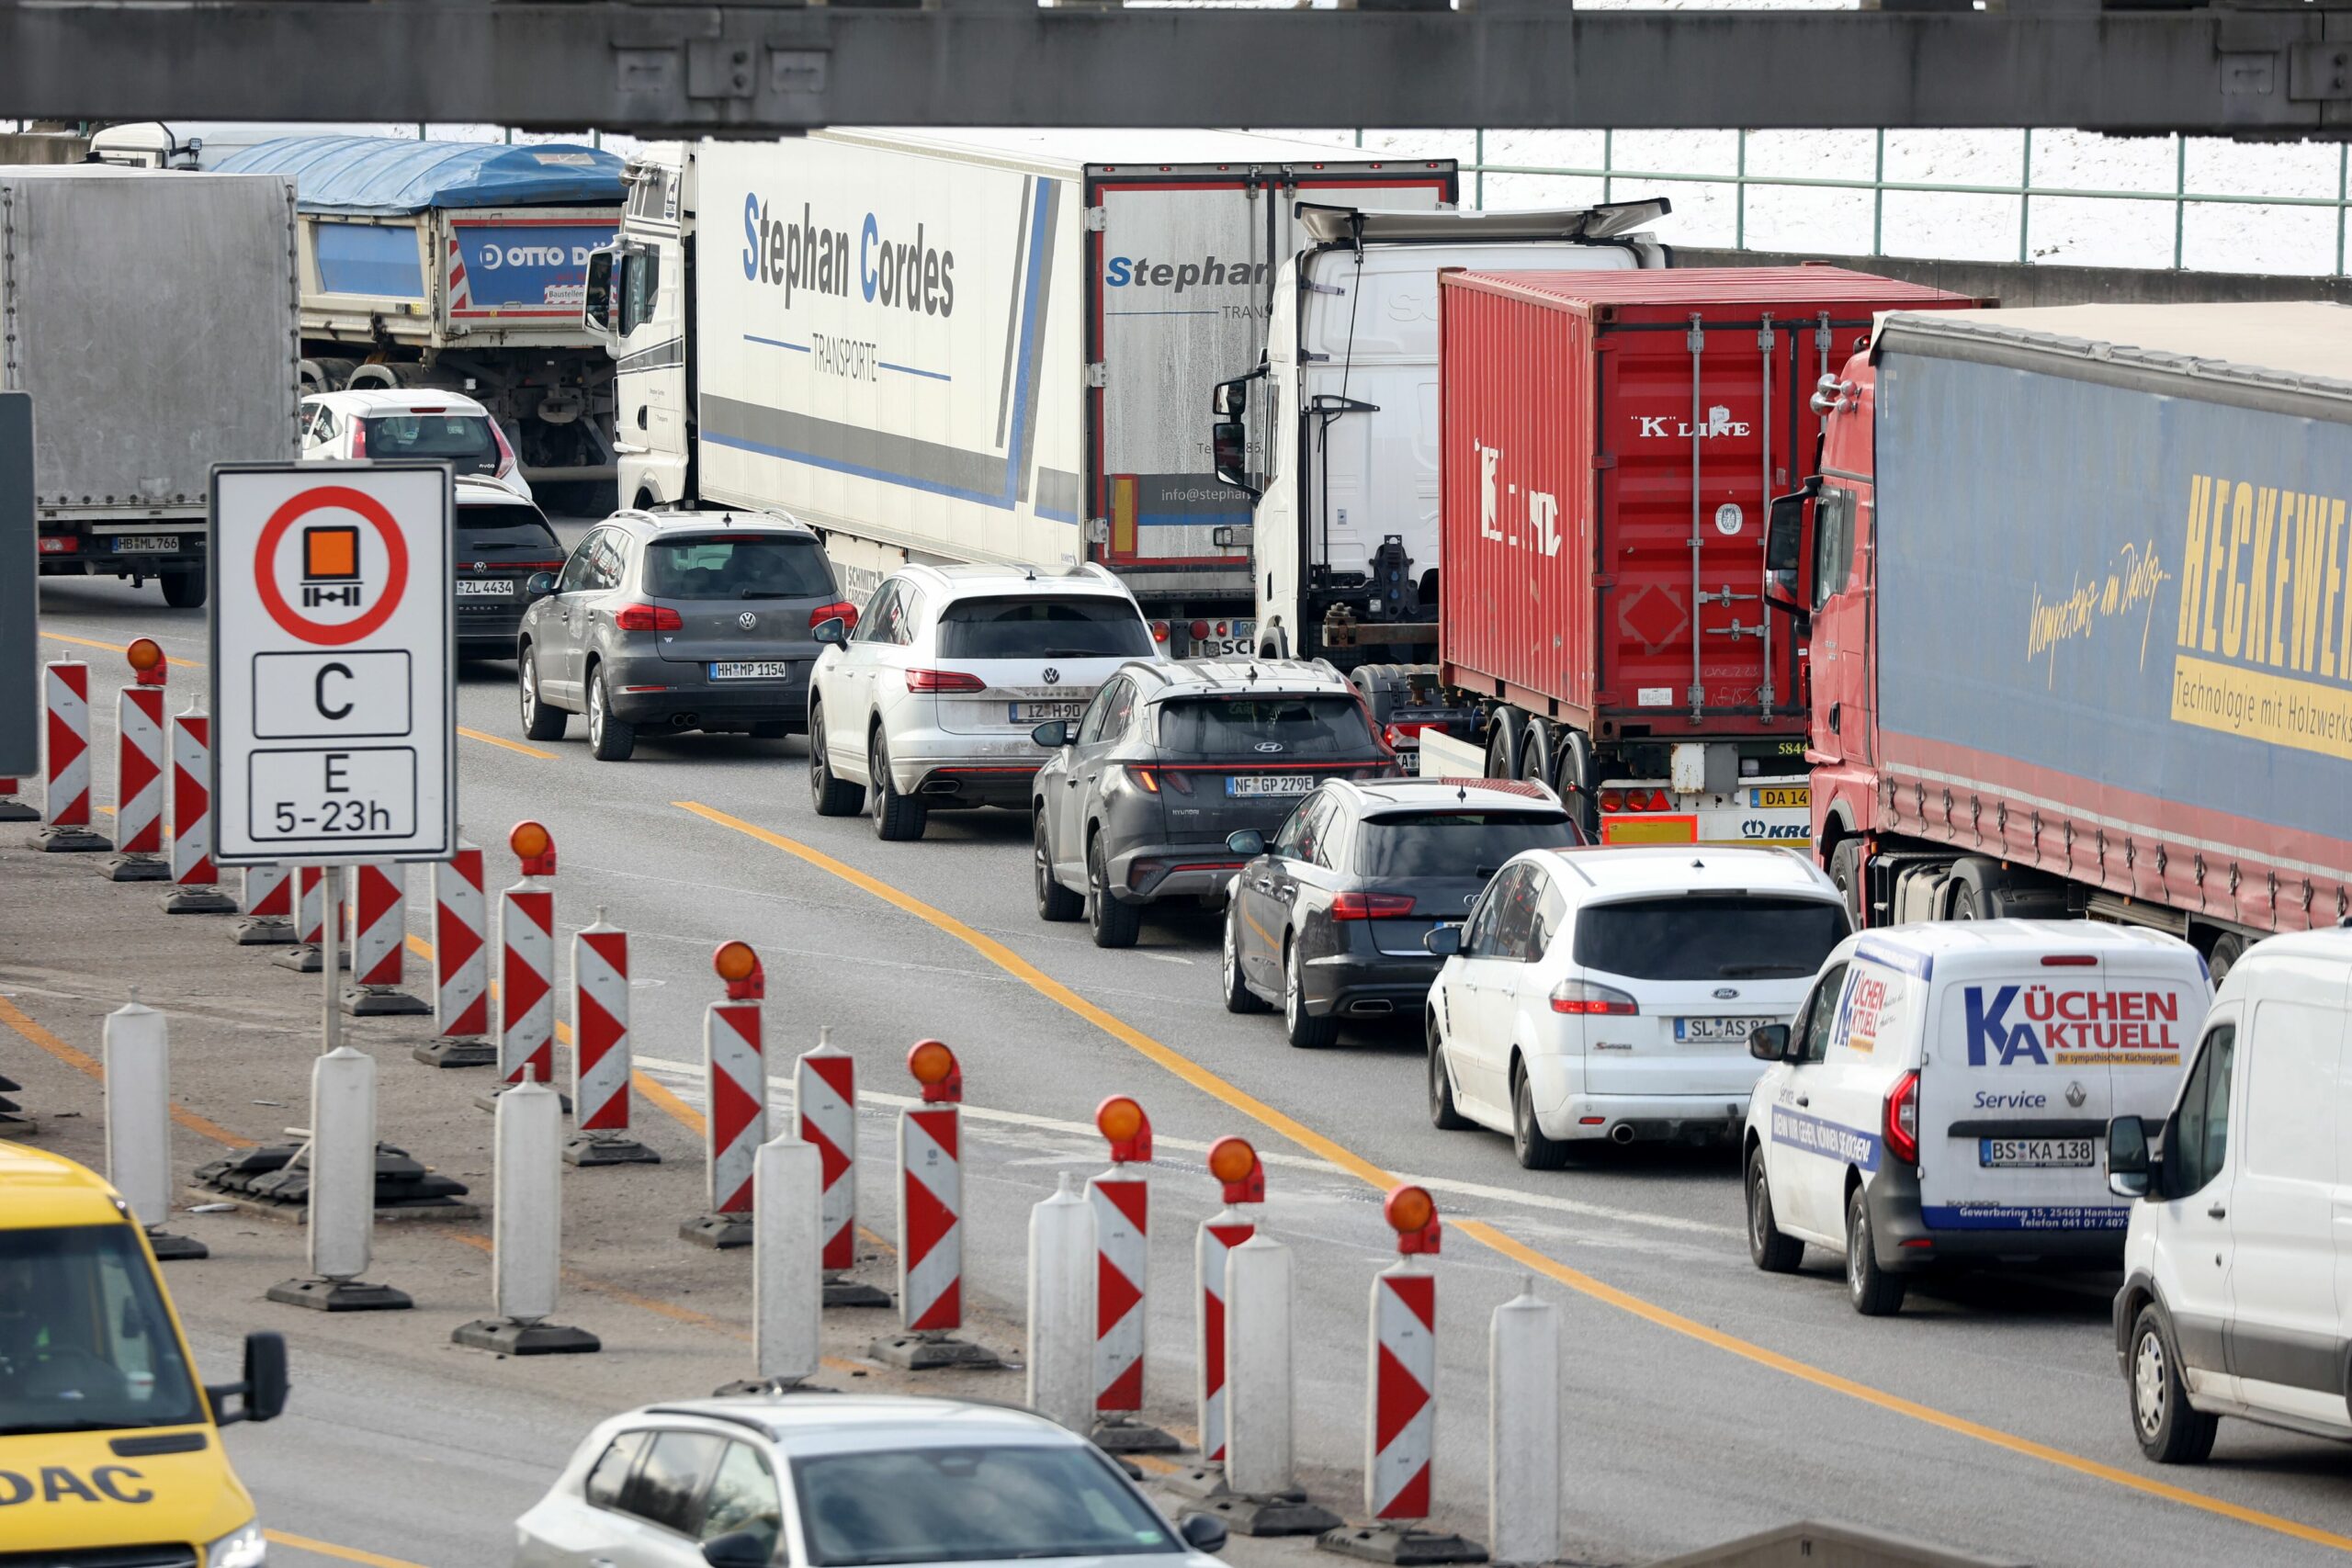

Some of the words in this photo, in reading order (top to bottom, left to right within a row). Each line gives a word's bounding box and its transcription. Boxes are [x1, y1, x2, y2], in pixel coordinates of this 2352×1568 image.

[506, 246, 565, 266] OTTO
[743, 192, 849, 310] Stephan
[861, 212, 955, 318] Cordes
[1105, 255, 1276, 293] Stephan
[812, 333, 876, 382] TRANSPORTE
[119, 539, 133, 549] HB
[141, 538, 154, 548] ML
[157, 537, 177, 548] 766
[466, 581, 481, 593] ZL
[483, 581, 513, 593] 4434
[718, 663, 732, 676] HH
[740, 663, 754, 676] MP
[758, 662, 785, 676] 1154
[315, 662, 355, 720] C
[2177, 671, 2255, 729] Technologie
[2260, 690, 2283, 729] mit
[1029, 705, 1044, 717] IZ
[1054, 705, 1061, 717] H
[1064, 704, 1080, 717] 90
[324, 753, 349, 794] E
[1236, 780, 1251, 792] NF
[1261, 779, 1277, 791] GP
[1282, 777, 1313, 791] 279E
[1766, 791, 1785, 805] DA
[1791, 790, 1807, 805] 14
[276, 800, 390, 832] 5-23h
[1691, 1021, 1713, 1036] SL
[1724, 1021, 1746, 1036] AS
[1999, 1023, 2179, 1066] AKTUELL
[1973, 1091, 2046, 1108] Service
[1993, 1143, 2016, 1158] BS
[2029, 1142, 2052, 1158] KA
[2057, 1142, 2090, 1158] 138
[1960, 1208, 2028, 1219] Gewerbering
[2020, 1218, 2058, 1227] Telefon
[2062, 1218, 2080, 1227] 041
